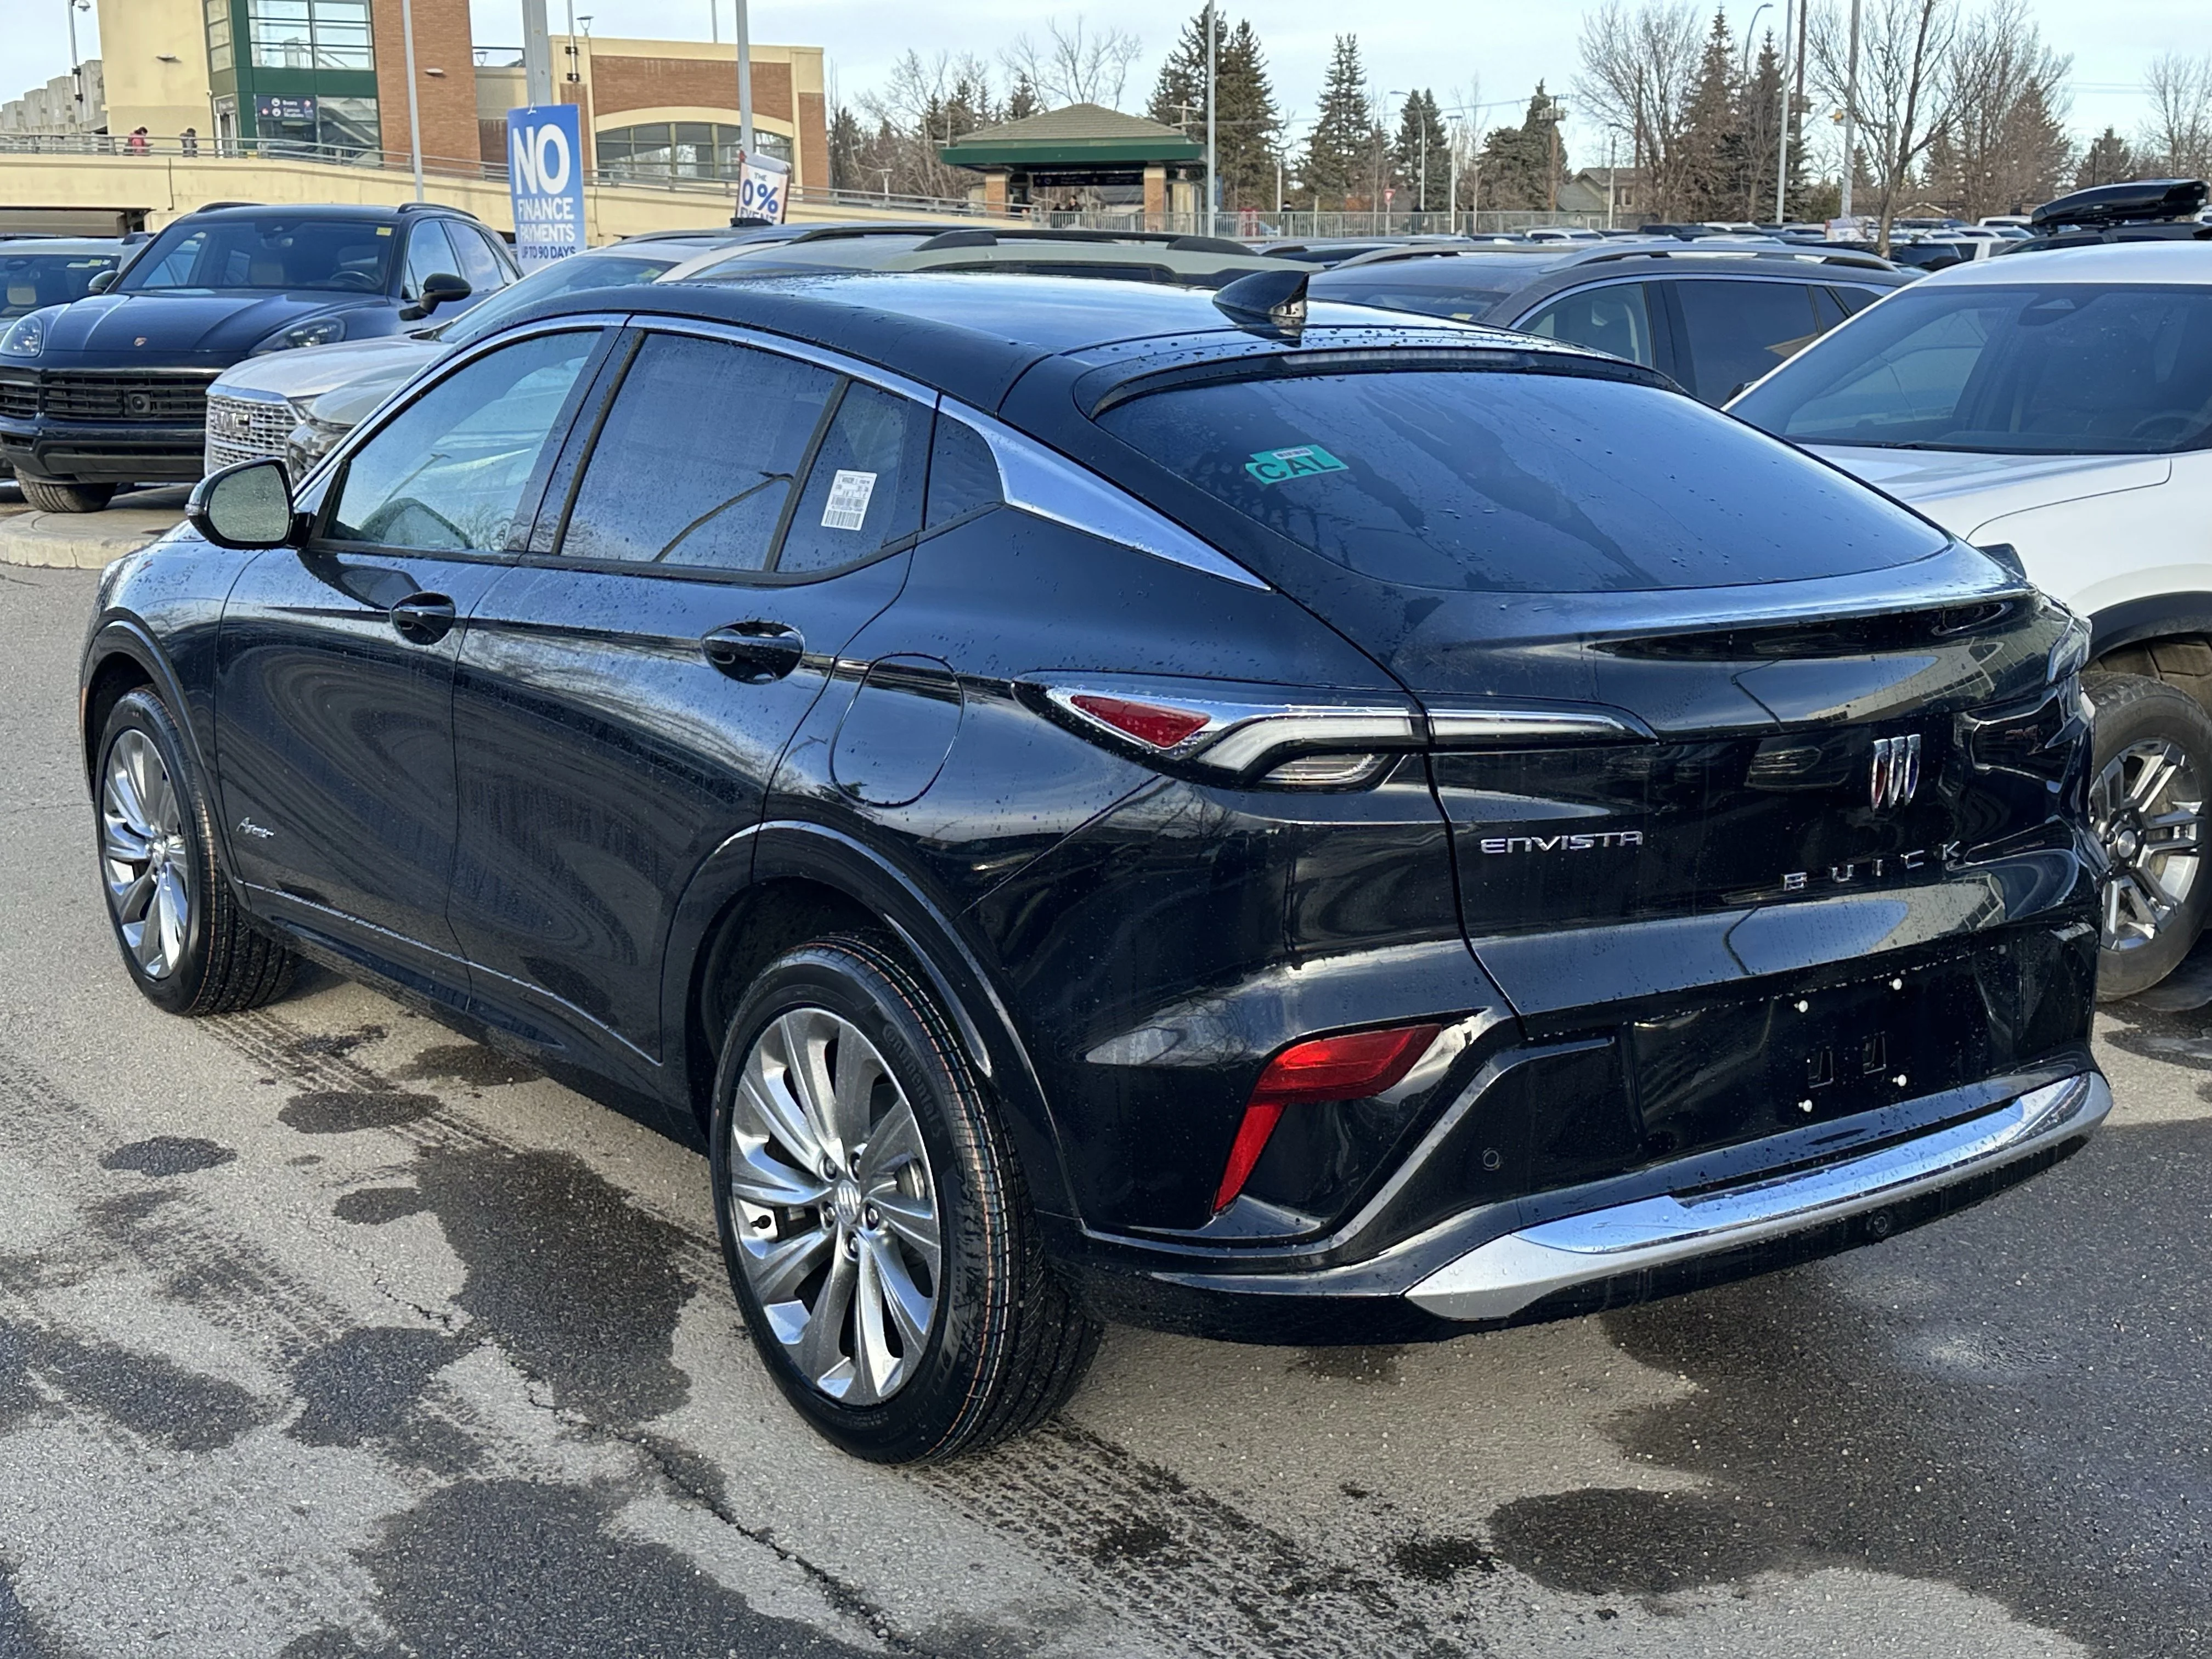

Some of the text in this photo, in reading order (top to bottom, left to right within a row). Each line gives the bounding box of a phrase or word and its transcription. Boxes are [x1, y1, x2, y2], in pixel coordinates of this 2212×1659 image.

[512, 123, 570, 194] NO
[742, 179, 779, 214] 0%
[517, 198, 574, 221] FINANCE
[521, 223, 575, 242] PAYMENTS
[528, 246, 537, 258] TO
[538, 246, 549, 259] 90
[1255, 455, 1341, 479] CAL
[1480, 831, 1644, 854] ENVISTA
[1781, 840, 1961, 891] BUICK
[882, 1023, 940, 1122] Continental
